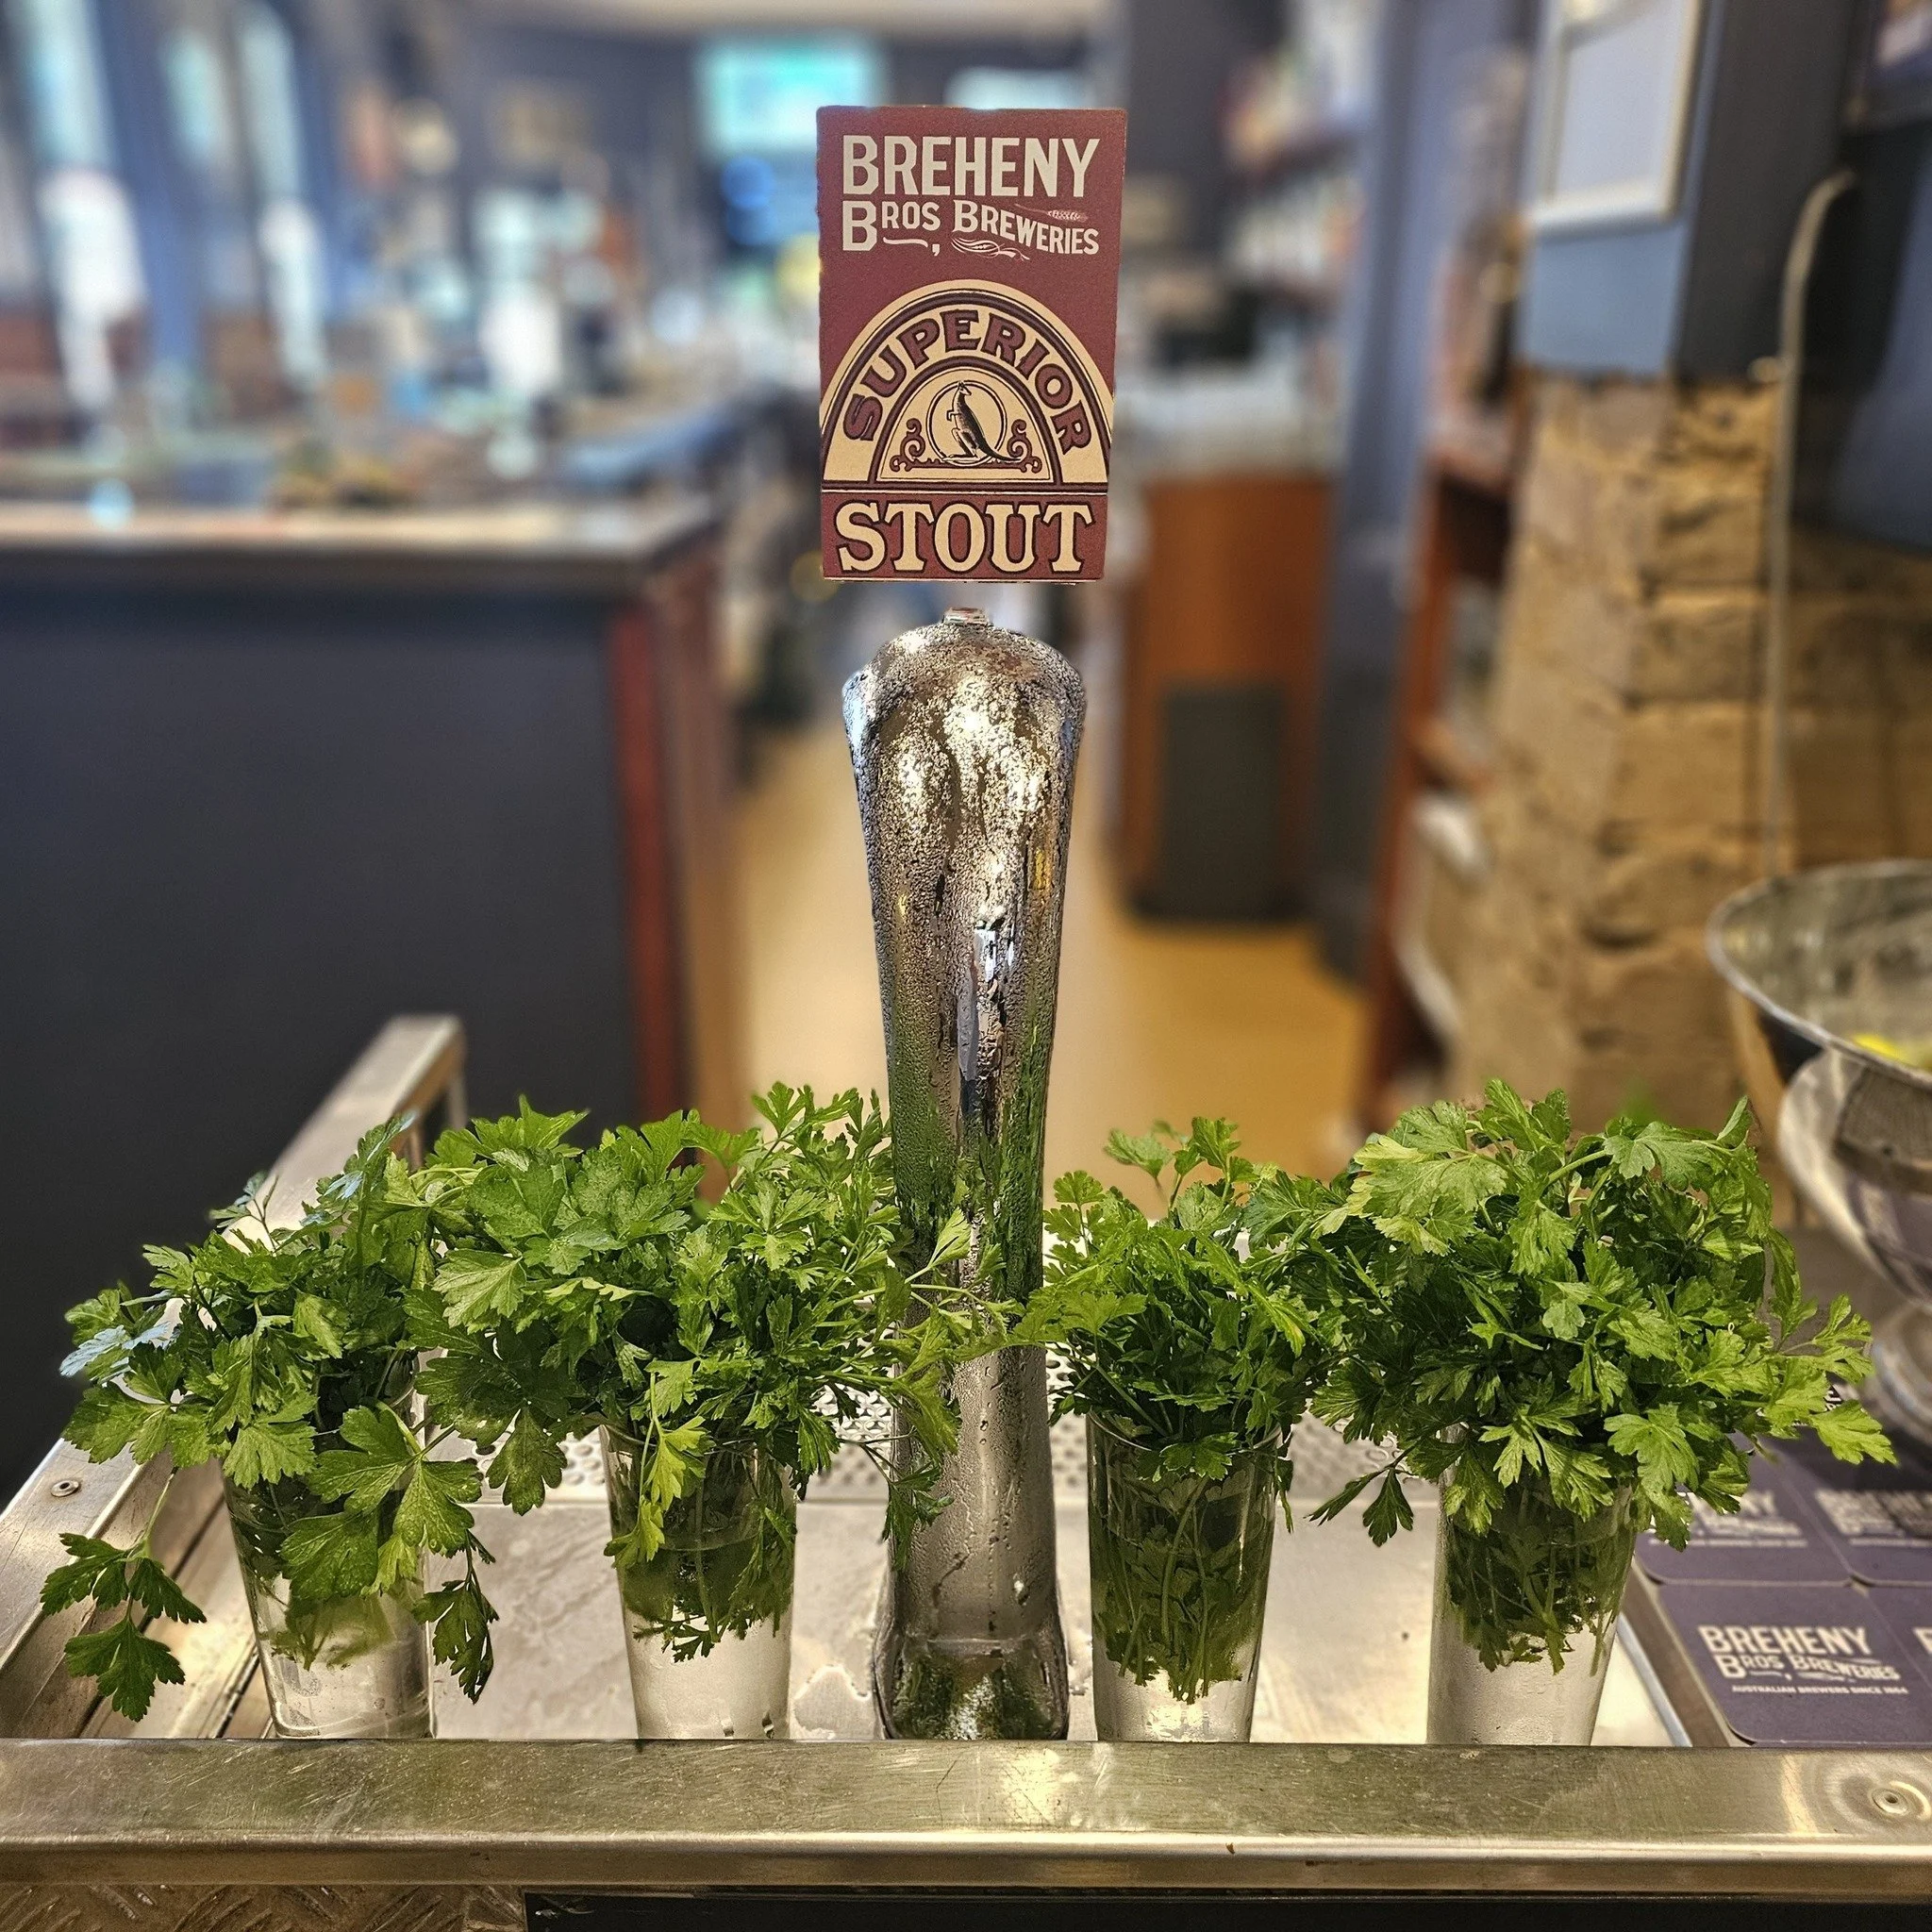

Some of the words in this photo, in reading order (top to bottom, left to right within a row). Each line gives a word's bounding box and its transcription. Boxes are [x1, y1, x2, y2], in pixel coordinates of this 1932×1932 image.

[842, 135, 1101, 198] BREHENY
[951, 199, 1100, 255] BREWERIES
[843, 308, 1091, 456] SUPERIOR
[835, 500, 1094, 574] STOUT
[1698, 1625, 1872, 1655] BREHENY
